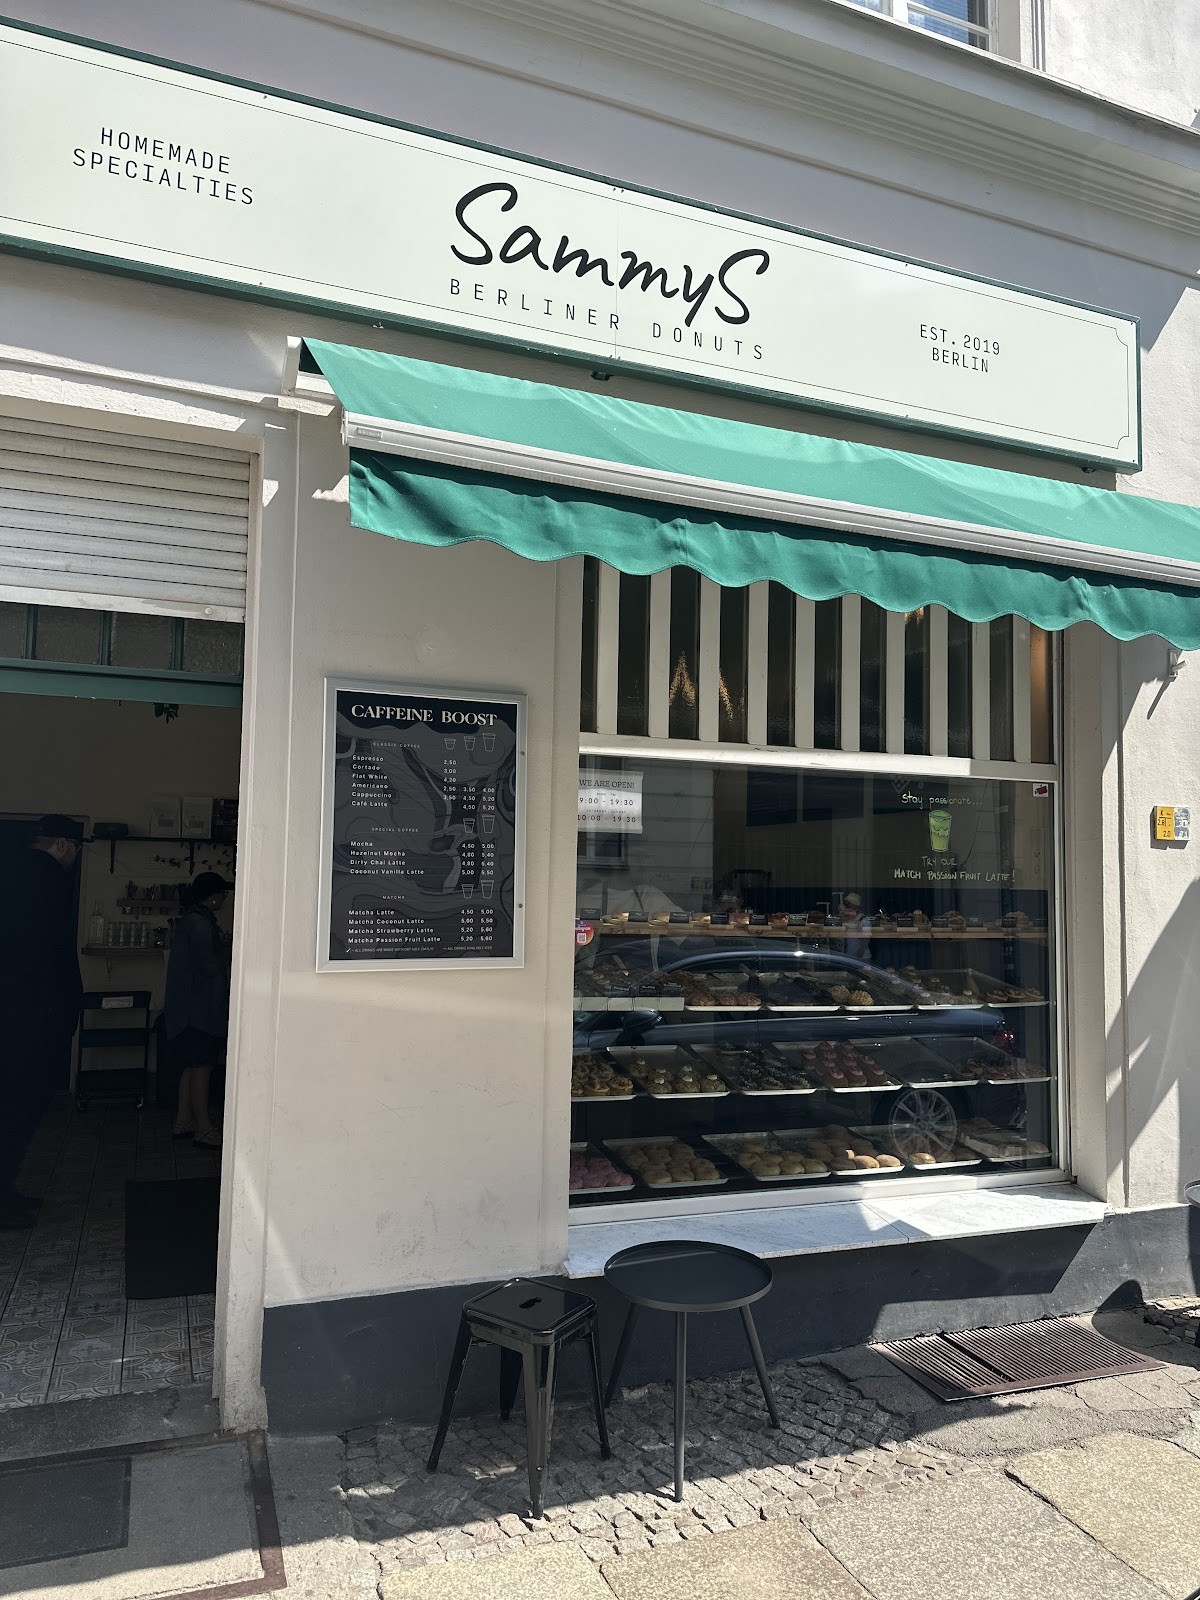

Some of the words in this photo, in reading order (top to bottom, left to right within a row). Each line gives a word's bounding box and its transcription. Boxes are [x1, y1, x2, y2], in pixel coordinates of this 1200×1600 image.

[101, 127, 230, 174] HOMEMADE
[73, 148, 253, 205] SPECIALTIES
[450, 182, 770, 327] SammyS
[450, 279, 619, 330] BERLINER
[652, 322, 763, 360] DONUTS
[932, 347, 988, 372] BERLIN
[351, 704, 434, 722] CAFFEINE
[441, 710, 498, 726] BOOST
[894, 868, 922, 880] MATCH
[960, 870, 980, 880] FRUIT
[921, 856, 937, 867] TRY
